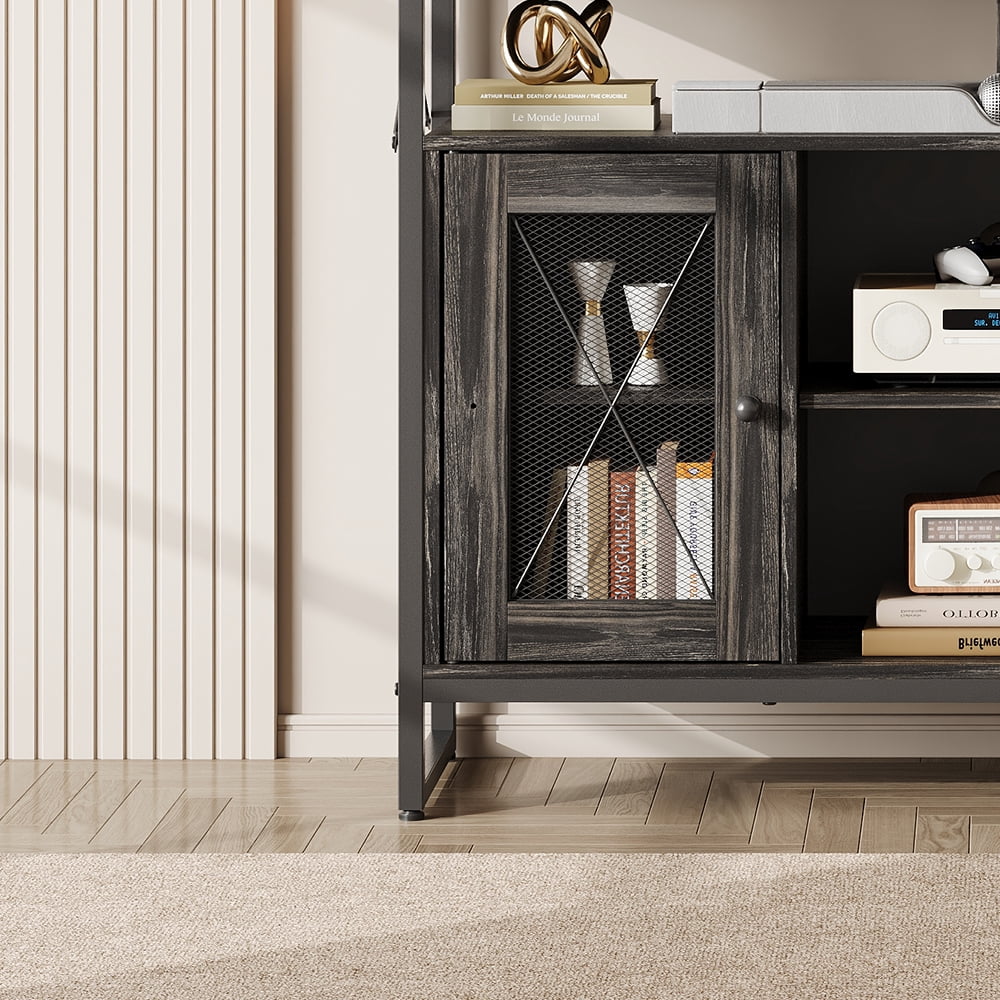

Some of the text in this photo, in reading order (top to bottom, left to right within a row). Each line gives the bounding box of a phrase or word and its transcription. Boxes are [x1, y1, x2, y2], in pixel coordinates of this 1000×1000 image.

[512, 112, 600, 123] Le Monde Journal
